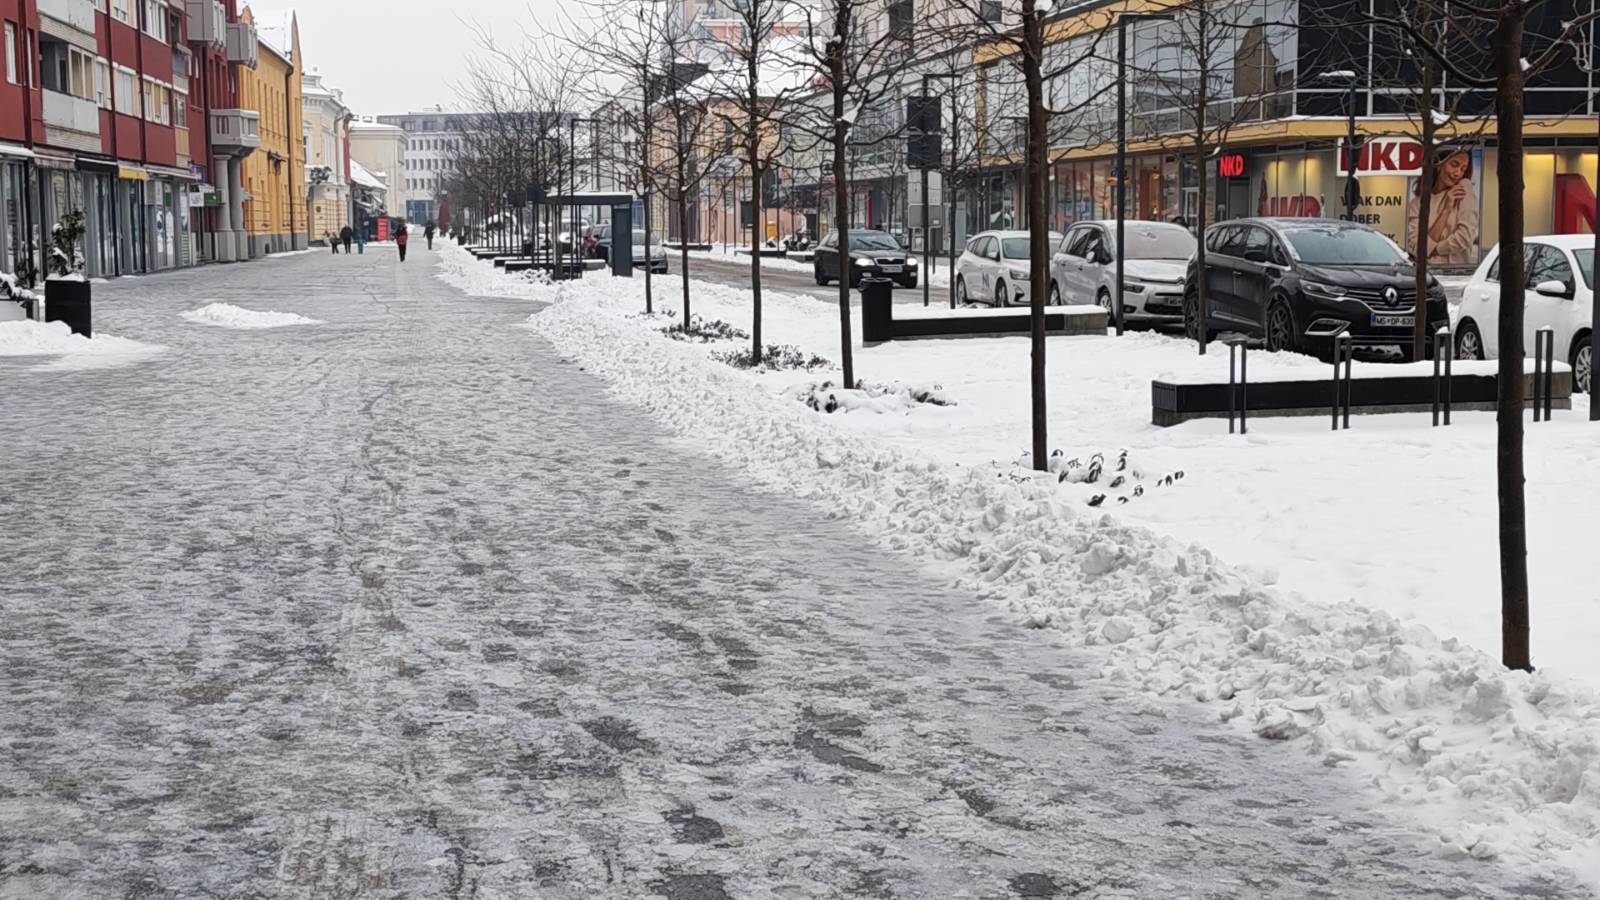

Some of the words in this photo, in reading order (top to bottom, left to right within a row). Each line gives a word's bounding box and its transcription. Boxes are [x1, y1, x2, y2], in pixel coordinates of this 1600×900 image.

[1220, 155, 1243, 177] NKD
[1340, 142, 1424, 171] NKD
[1375, 196, 1402, 206] DAN
